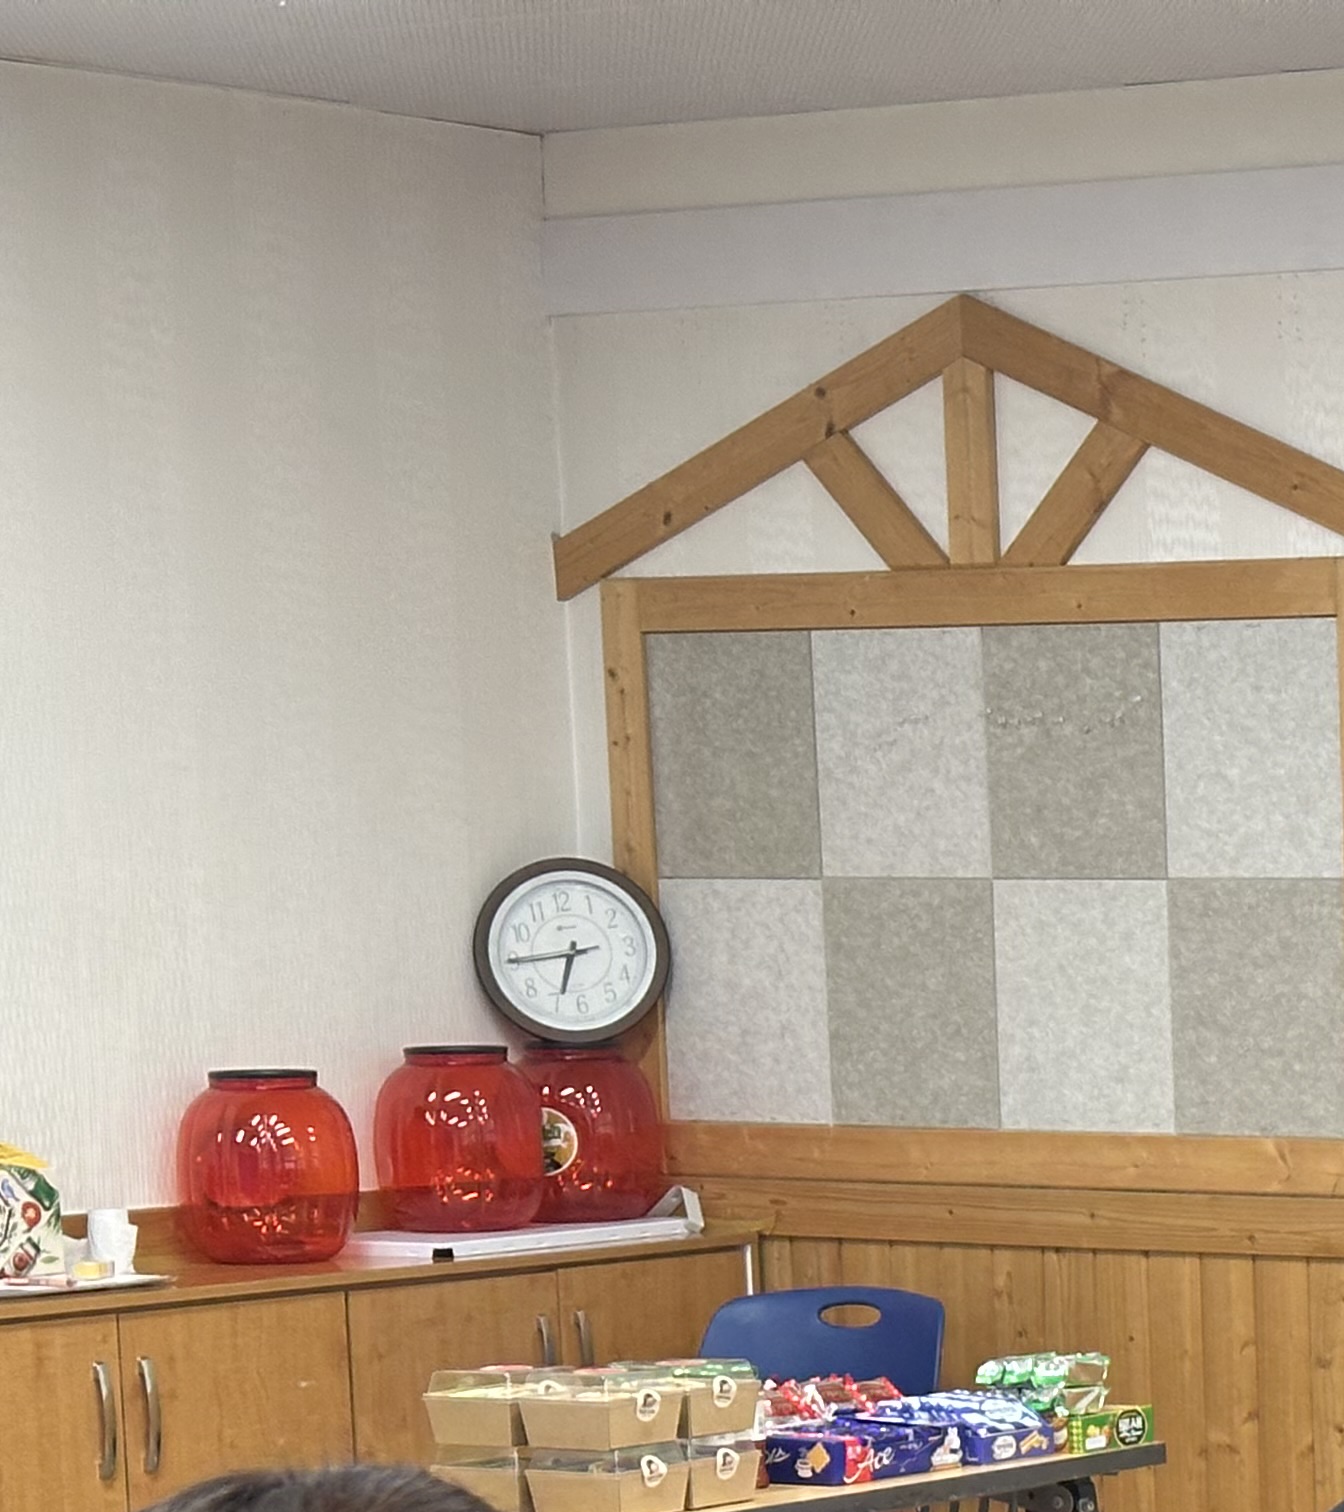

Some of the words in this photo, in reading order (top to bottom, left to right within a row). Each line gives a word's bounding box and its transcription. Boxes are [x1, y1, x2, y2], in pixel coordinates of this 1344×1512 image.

[530, 901, 545, 922] 11
[552, 891, 571, 912] 12
[605, 908, 618, 929] 2
[512, 923, 530, 943] 10
[623, 936, 636, 956] 3
[620, 965, 631, 986] 4
[524, 978, 538, 998] 8
[603, 982, 617, 1002] 5
[547, 992, 562, 1014] 7
[576, 994, 589, 1014] 6
[843, 1447, 895, 1483] Ace
